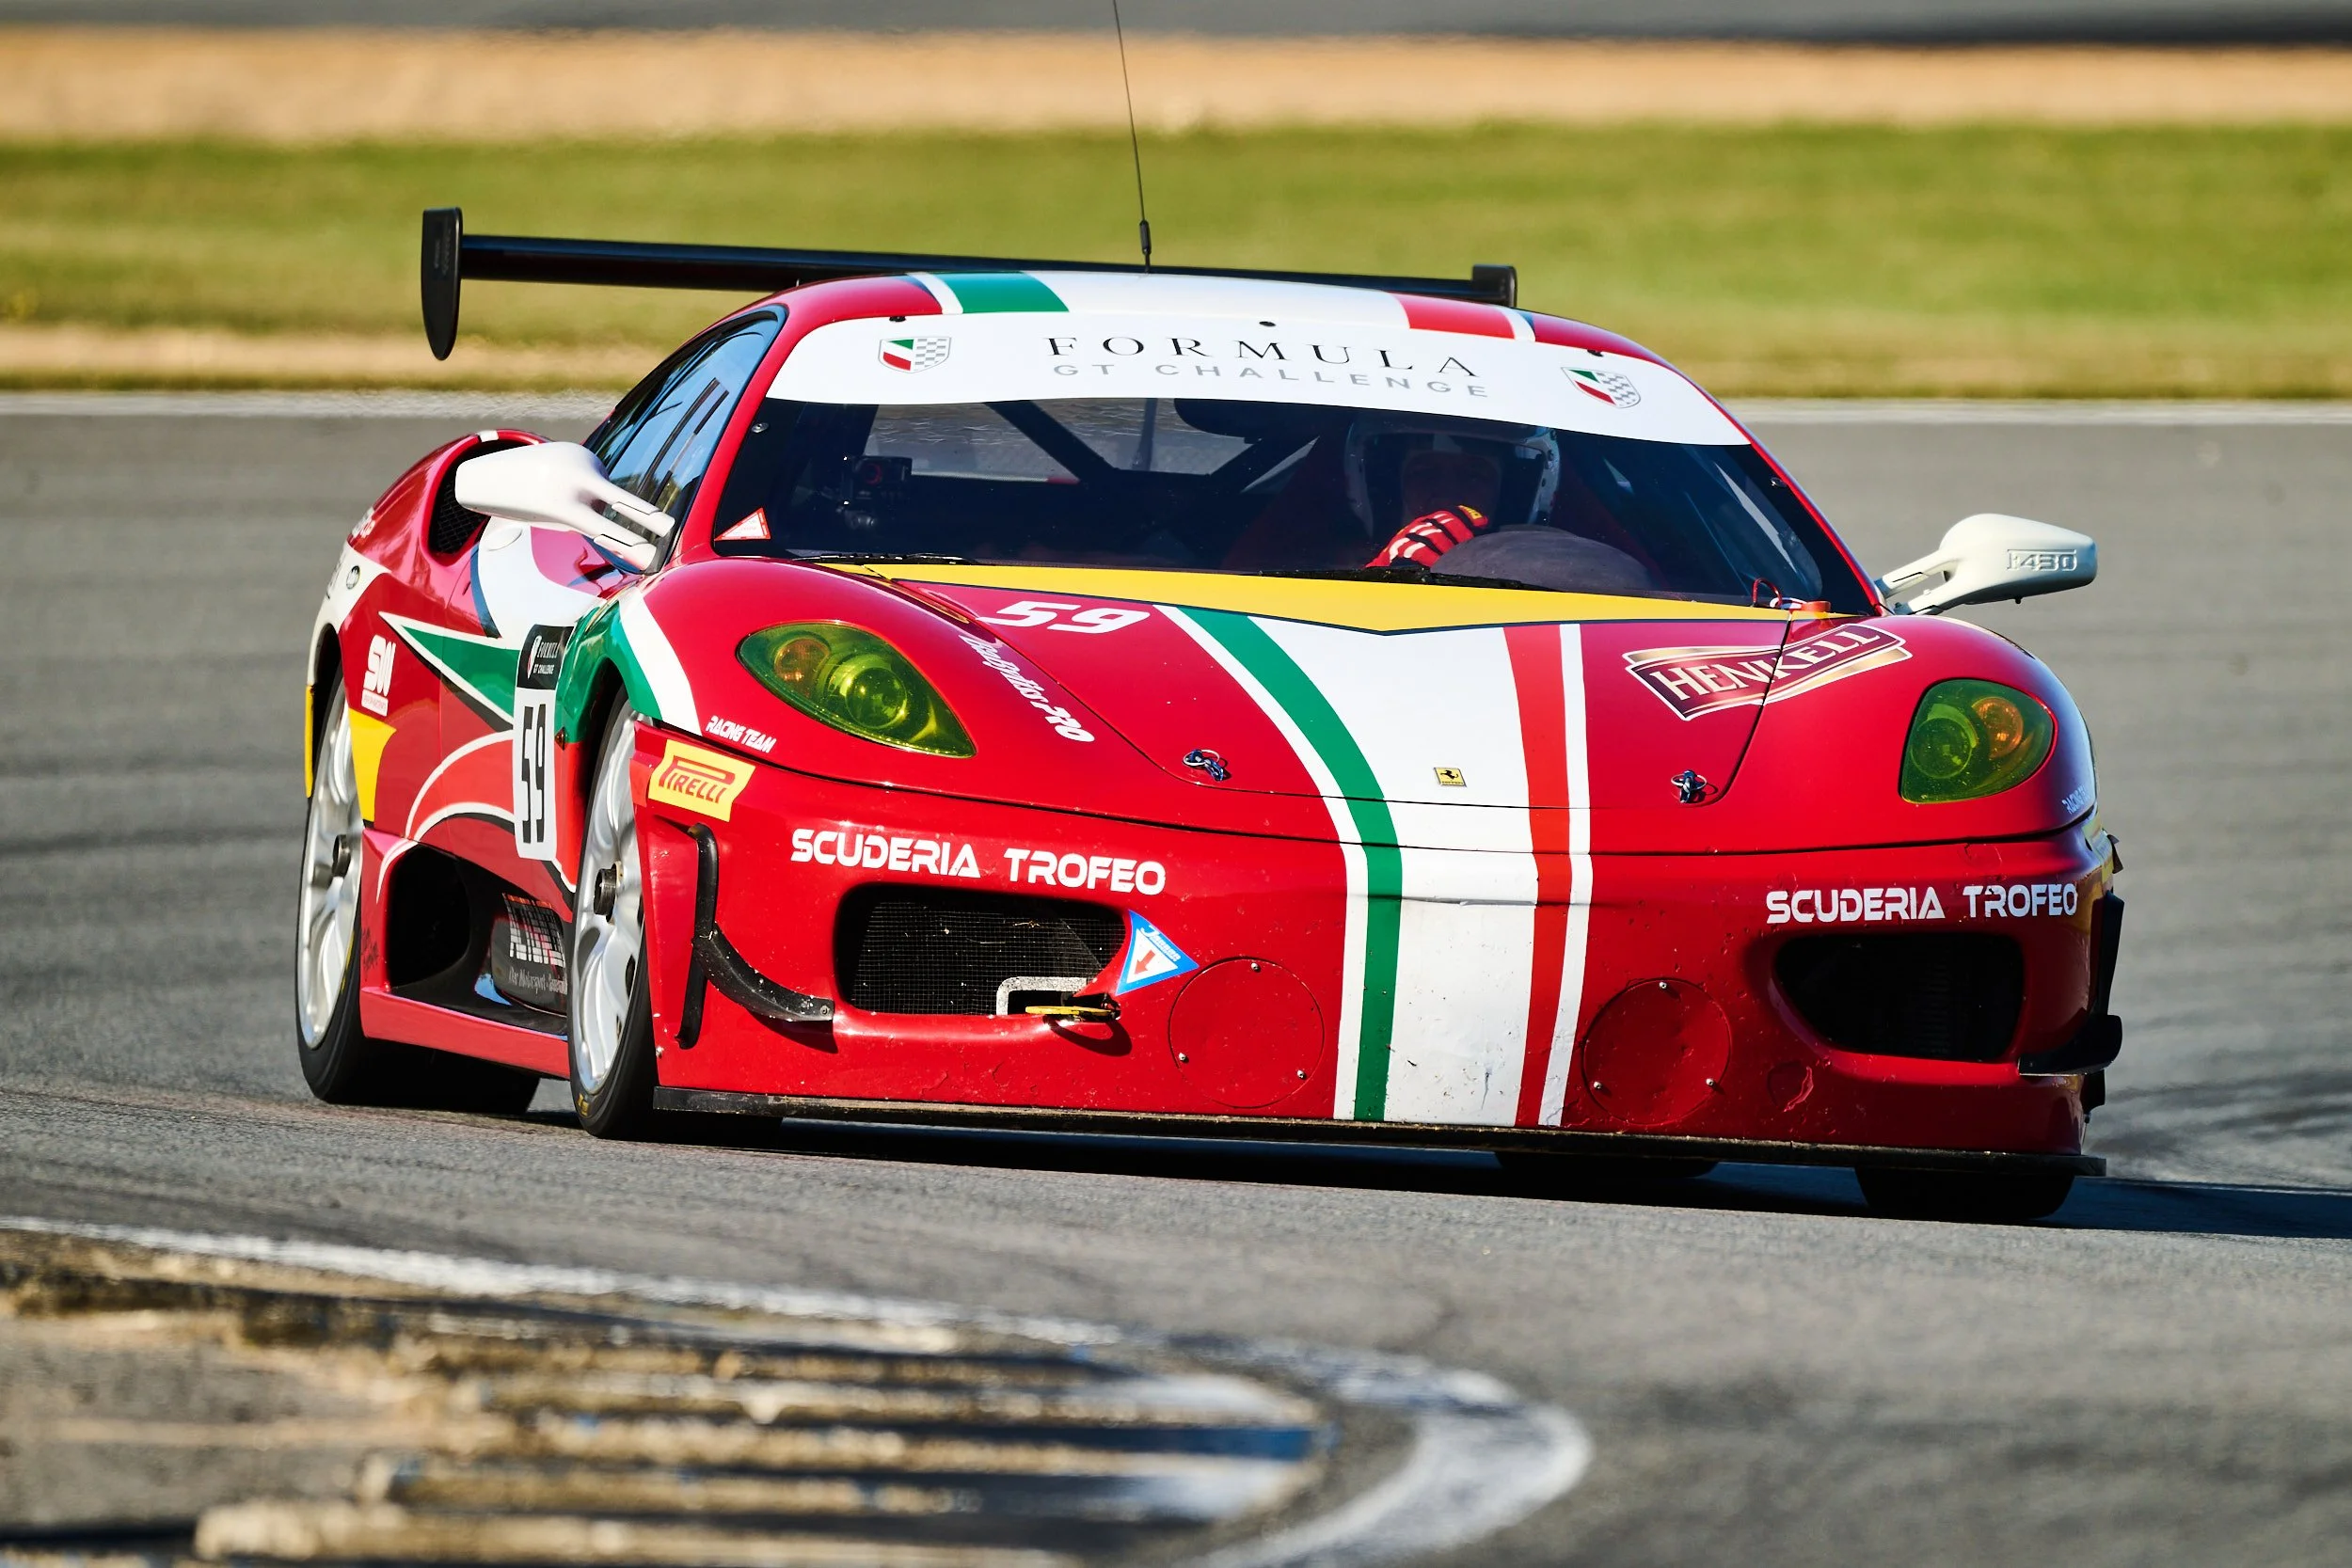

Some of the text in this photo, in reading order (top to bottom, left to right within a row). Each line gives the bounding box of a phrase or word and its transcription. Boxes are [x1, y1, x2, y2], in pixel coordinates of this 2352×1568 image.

[1044, 336, 1480, 378] FORMULA
[1053, 363, 1487, 398] GT CHALLENGE
[975, 600, 1151, 634] 59
[1648, 630, 1881, 701] HENKELL
[706, 715, 777, 753] RACING TEAM
[521, 704, 547, 844] 59
[659, 754, 736, 804] PIRELLI
[790, 828, 1167, 895] SCUDERIA TROFEO
[1766, 882, 2079, 925] SCUDERIA TROFEO
